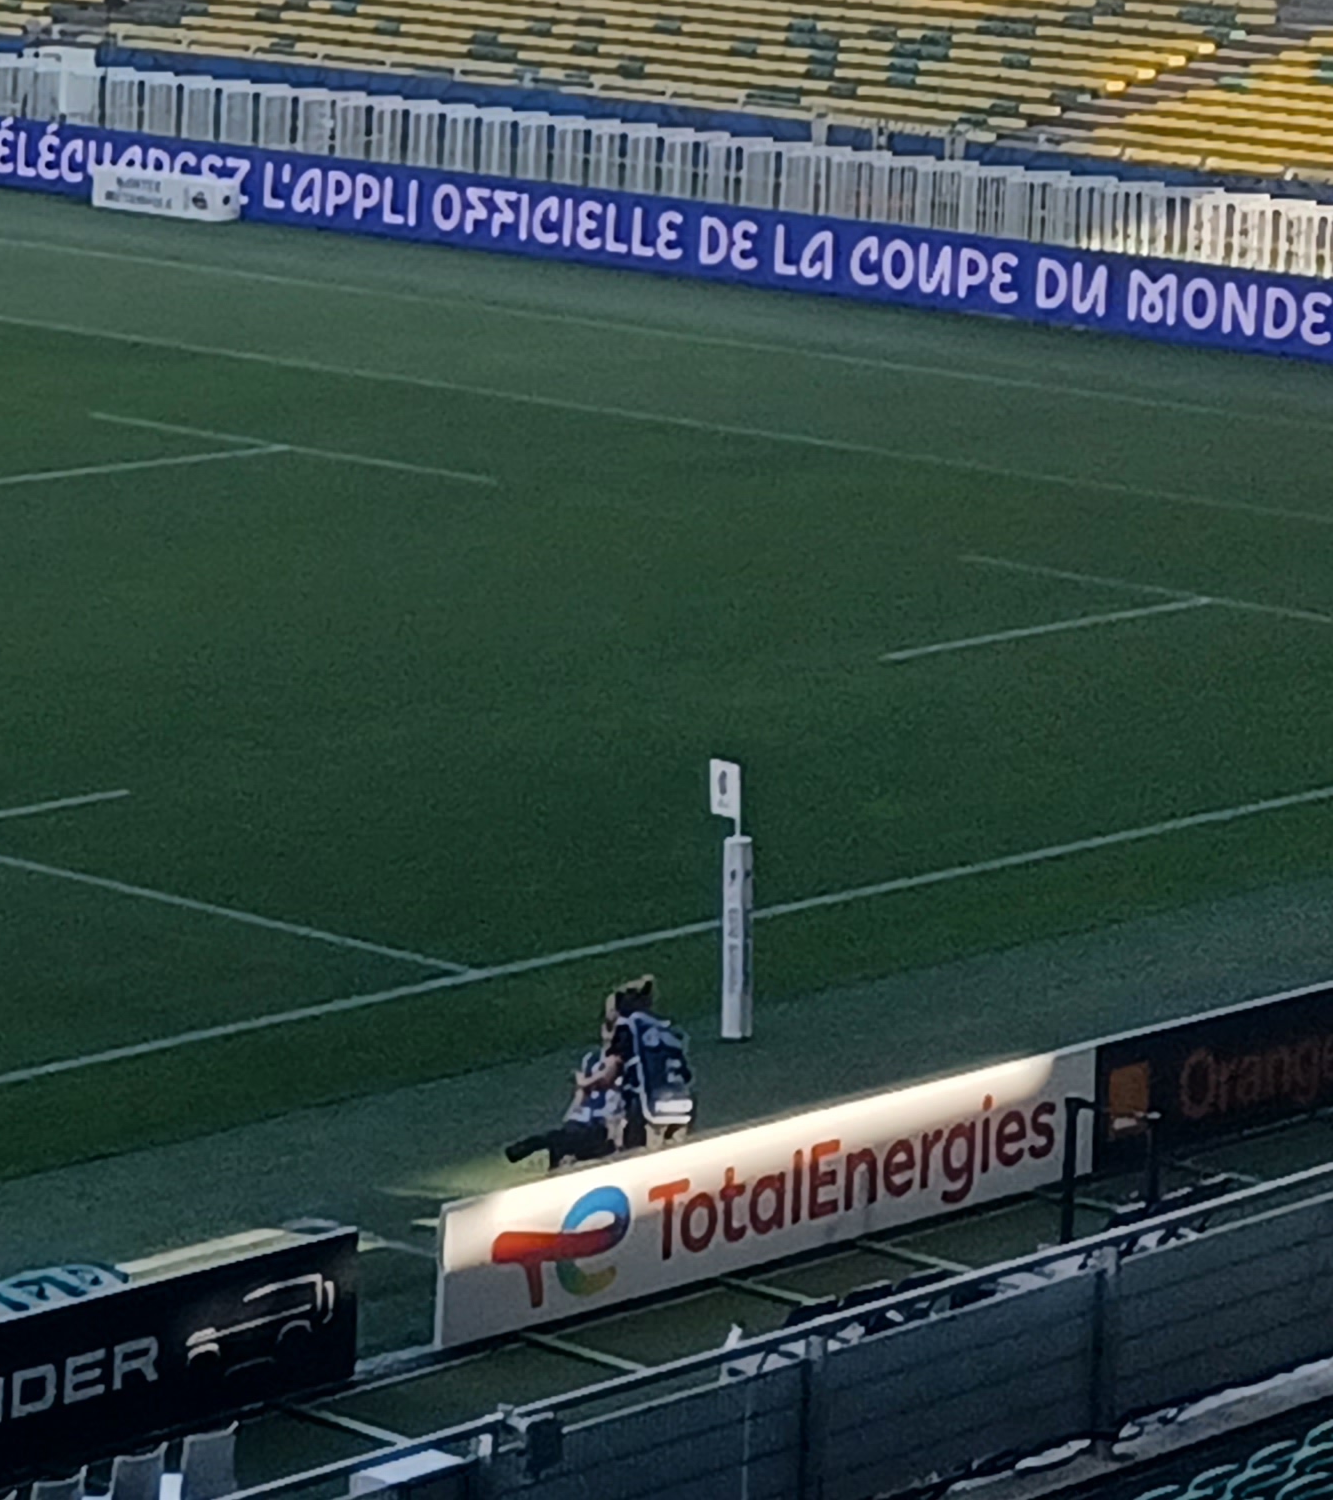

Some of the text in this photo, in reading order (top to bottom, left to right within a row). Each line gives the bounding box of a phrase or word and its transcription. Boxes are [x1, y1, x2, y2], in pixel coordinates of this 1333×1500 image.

[263, 160, 419, 227] L'APPLI
[432, 183, 684, 260] OFFICIELLE
[698, 214, 759, 271] DE
[773, 223, 833, 281] LA
[849, 235, 1019, 304] COUPE
[1035, 256, 1108, 318] DU
[1127, 268, 1332, 346] MONDE
[649, 1093, 1057, 1261] TotalEnergies
